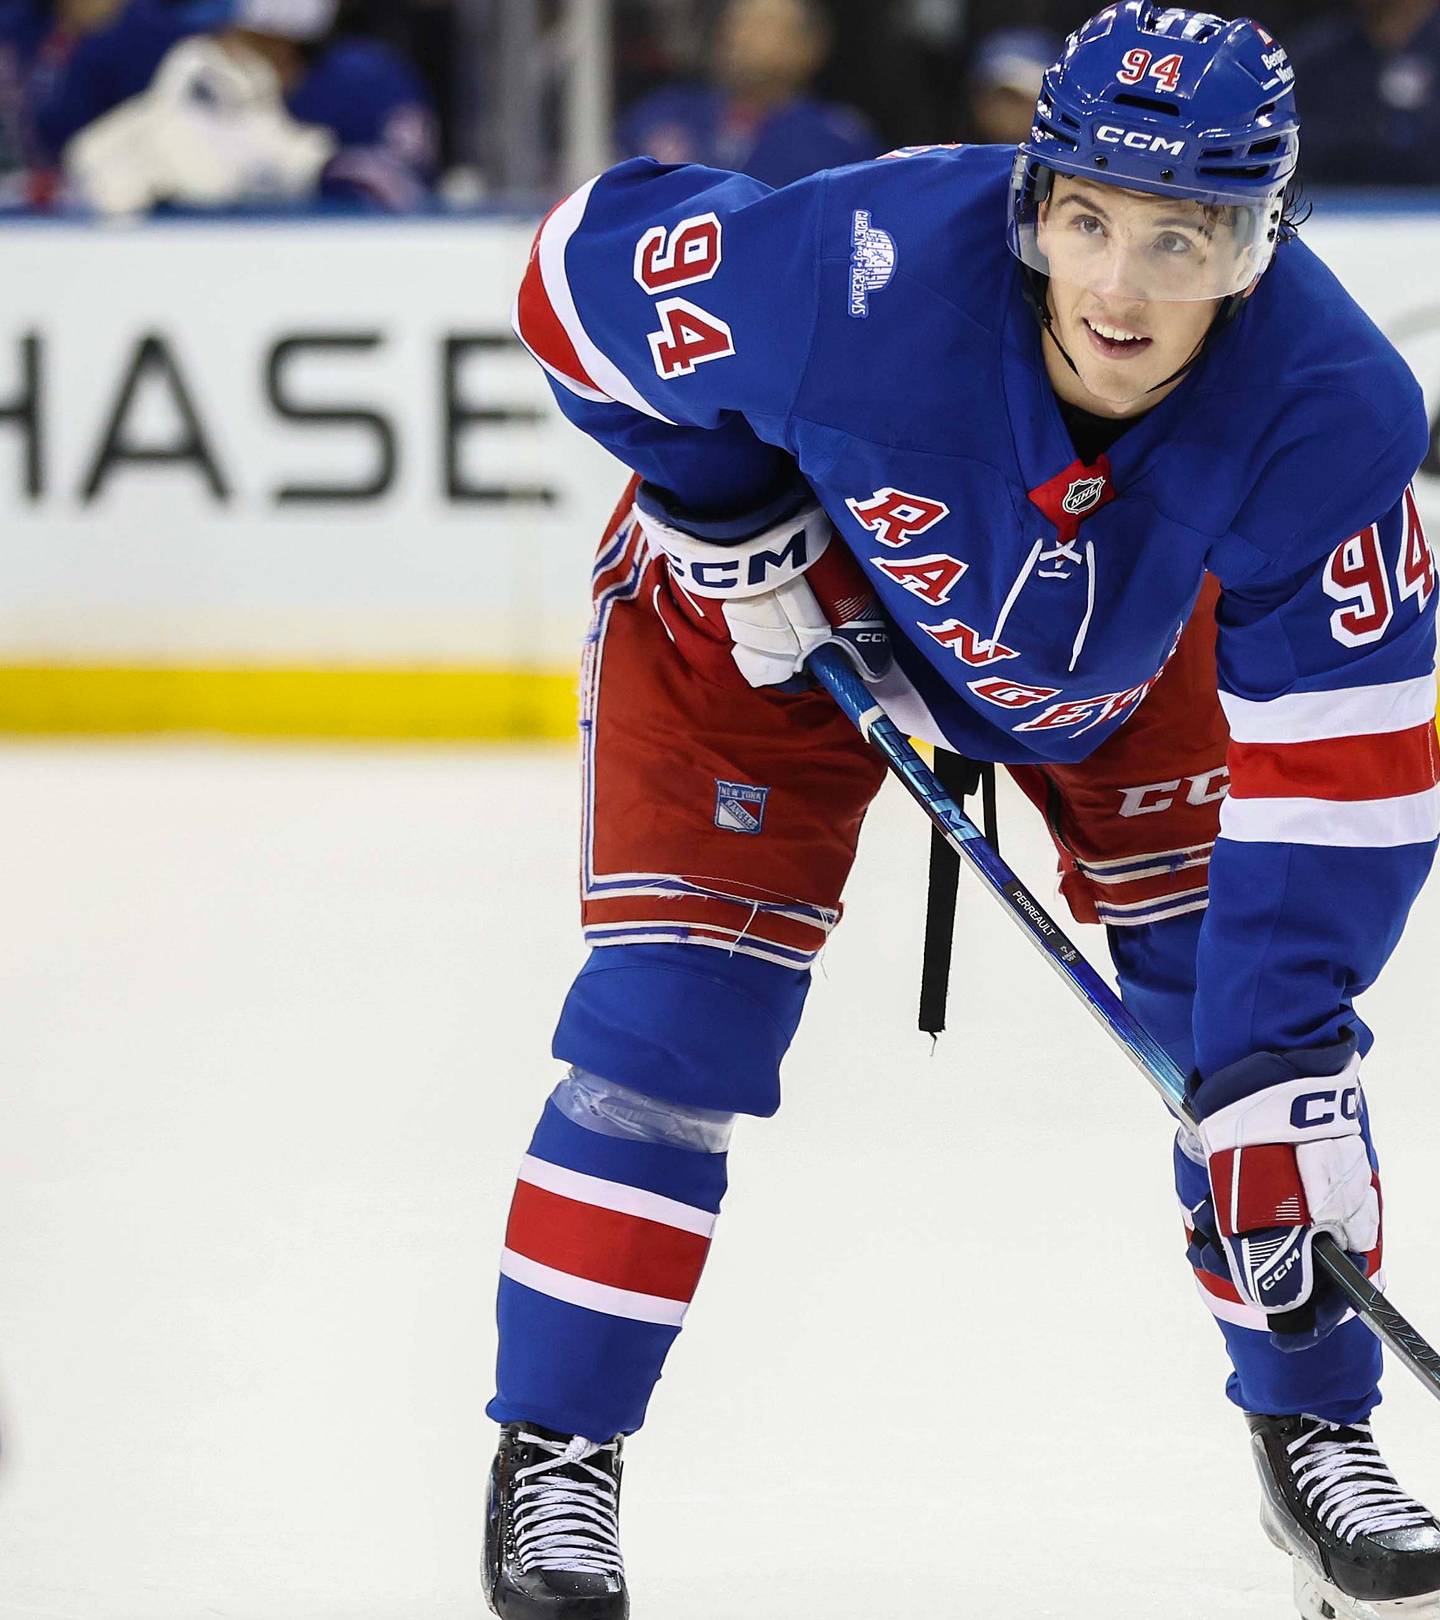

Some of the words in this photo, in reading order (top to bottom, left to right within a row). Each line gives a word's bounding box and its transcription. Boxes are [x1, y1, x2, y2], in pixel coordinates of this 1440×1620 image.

[1116, 48, 1184, 92] 94
[1096, 125, 1186, 156] CCM
[633, 211, 736, 381] 94
[1071, 485, 1098, 508] NHL
[1322, 483, 1435, 648] 94
[869, 718, 982, 841] CCM
[1012, 890, 1056, 936] PERREAULT
[1262, 1248, 1301, 1292] CCM
